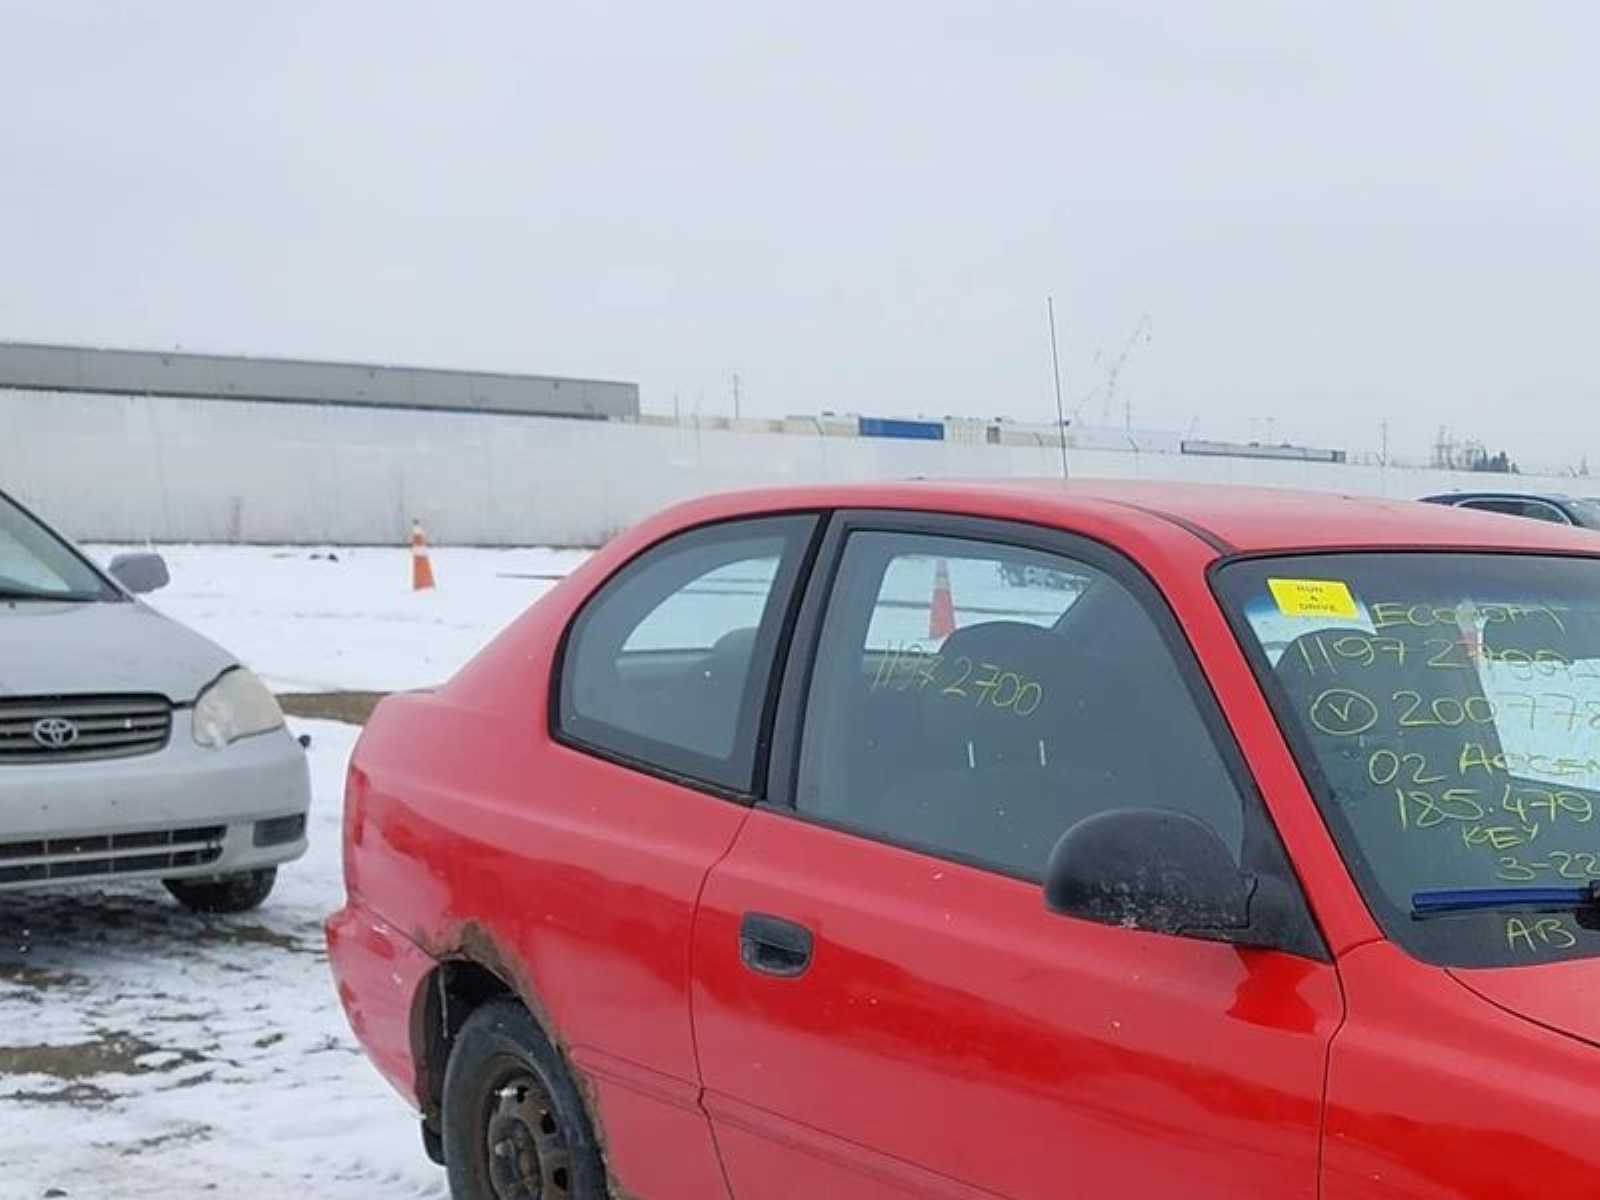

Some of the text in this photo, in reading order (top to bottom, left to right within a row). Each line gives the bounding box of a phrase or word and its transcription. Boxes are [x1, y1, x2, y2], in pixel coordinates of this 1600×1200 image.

[1369, 749, 1446, 785] 02
[1461, 822, 1539, 850] KEY
[1506, 918, 1577, 953] AB
